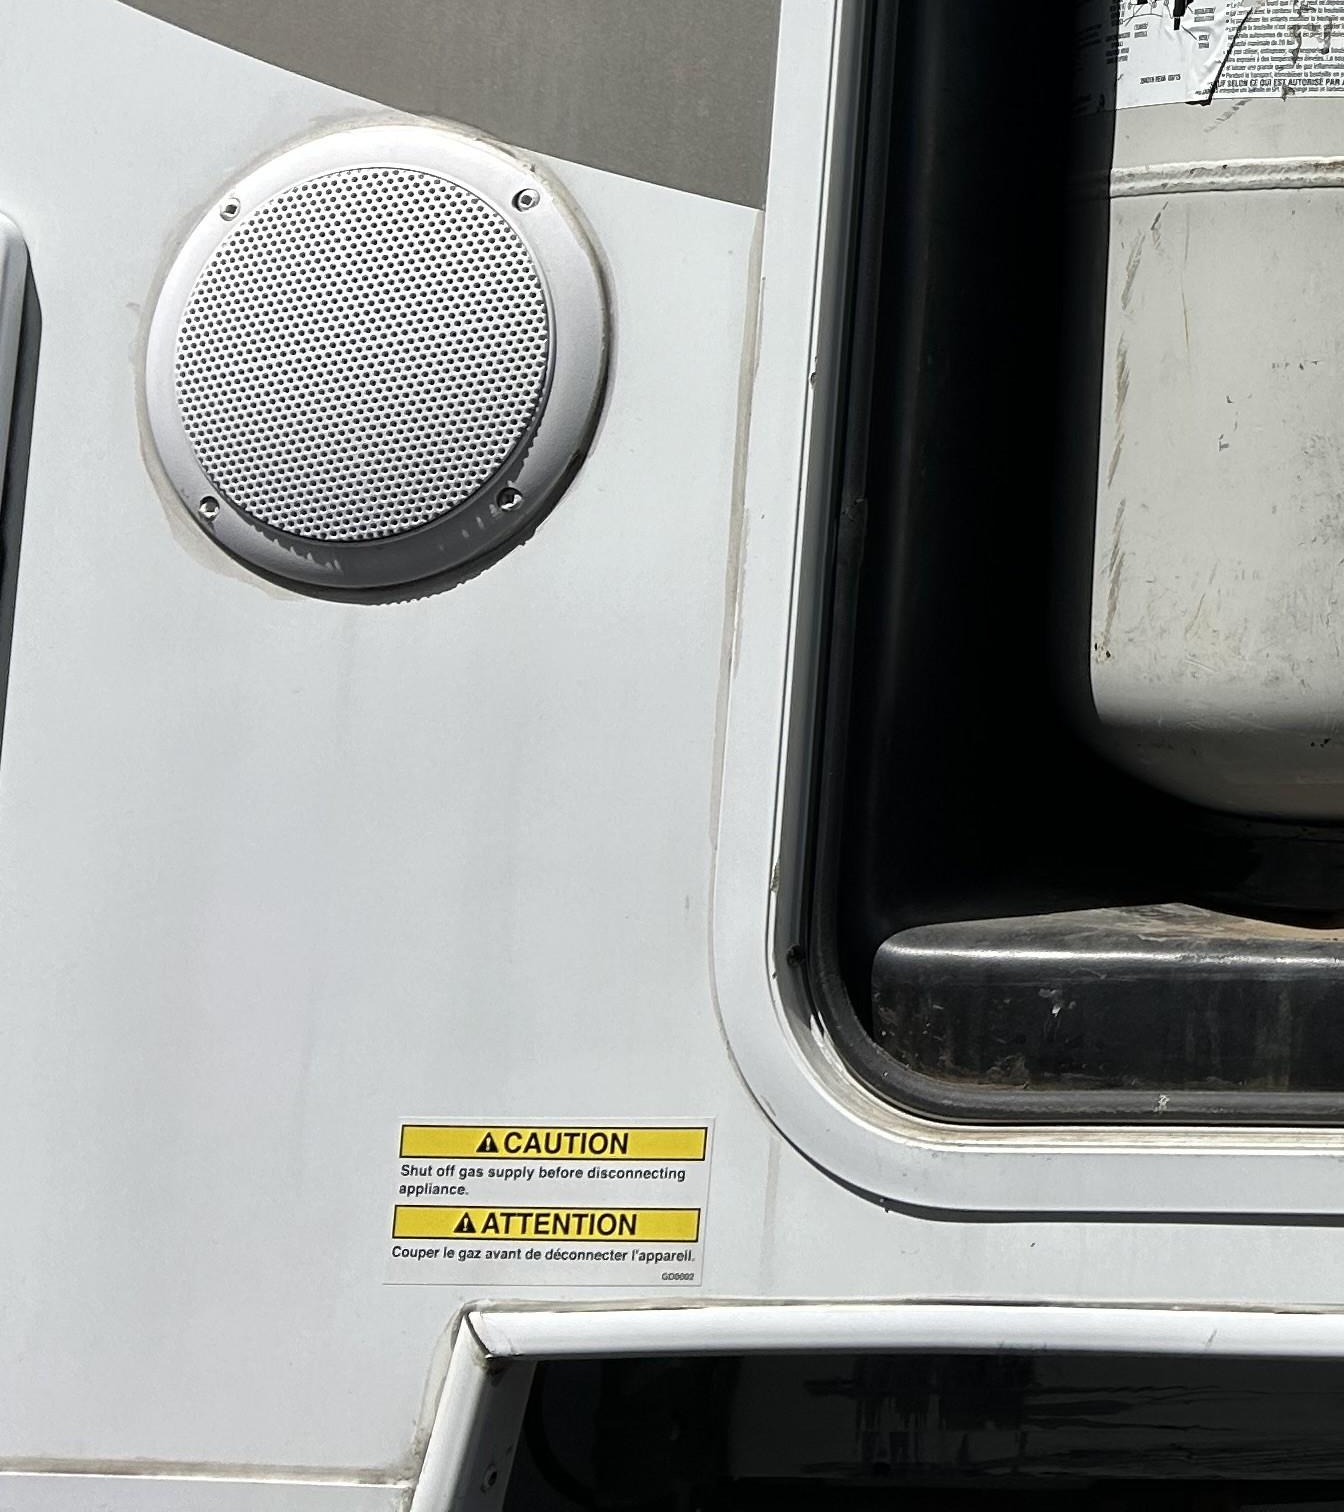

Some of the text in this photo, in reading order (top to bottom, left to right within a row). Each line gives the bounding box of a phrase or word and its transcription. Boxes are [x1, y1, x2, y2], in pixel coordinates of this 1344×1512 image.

[503, 1131, 629, 1155] CAUTION
[400, 1164, 686, 1183] Shut off gas supply before disconnecting
[399, 1183, 469, 1197] appliance.
[481, 1212, 637, 1236] ATTENTION
[392, 1245, 440, 1261] Couper
[443, 1246, 455, 1259] le
[458, 1250, 482, 1262] gaz
[485, 1248, 522, 1260] avant
[525, 1248, 541, 1261] de
[545, 1248, 628, 1262] déconnecter
